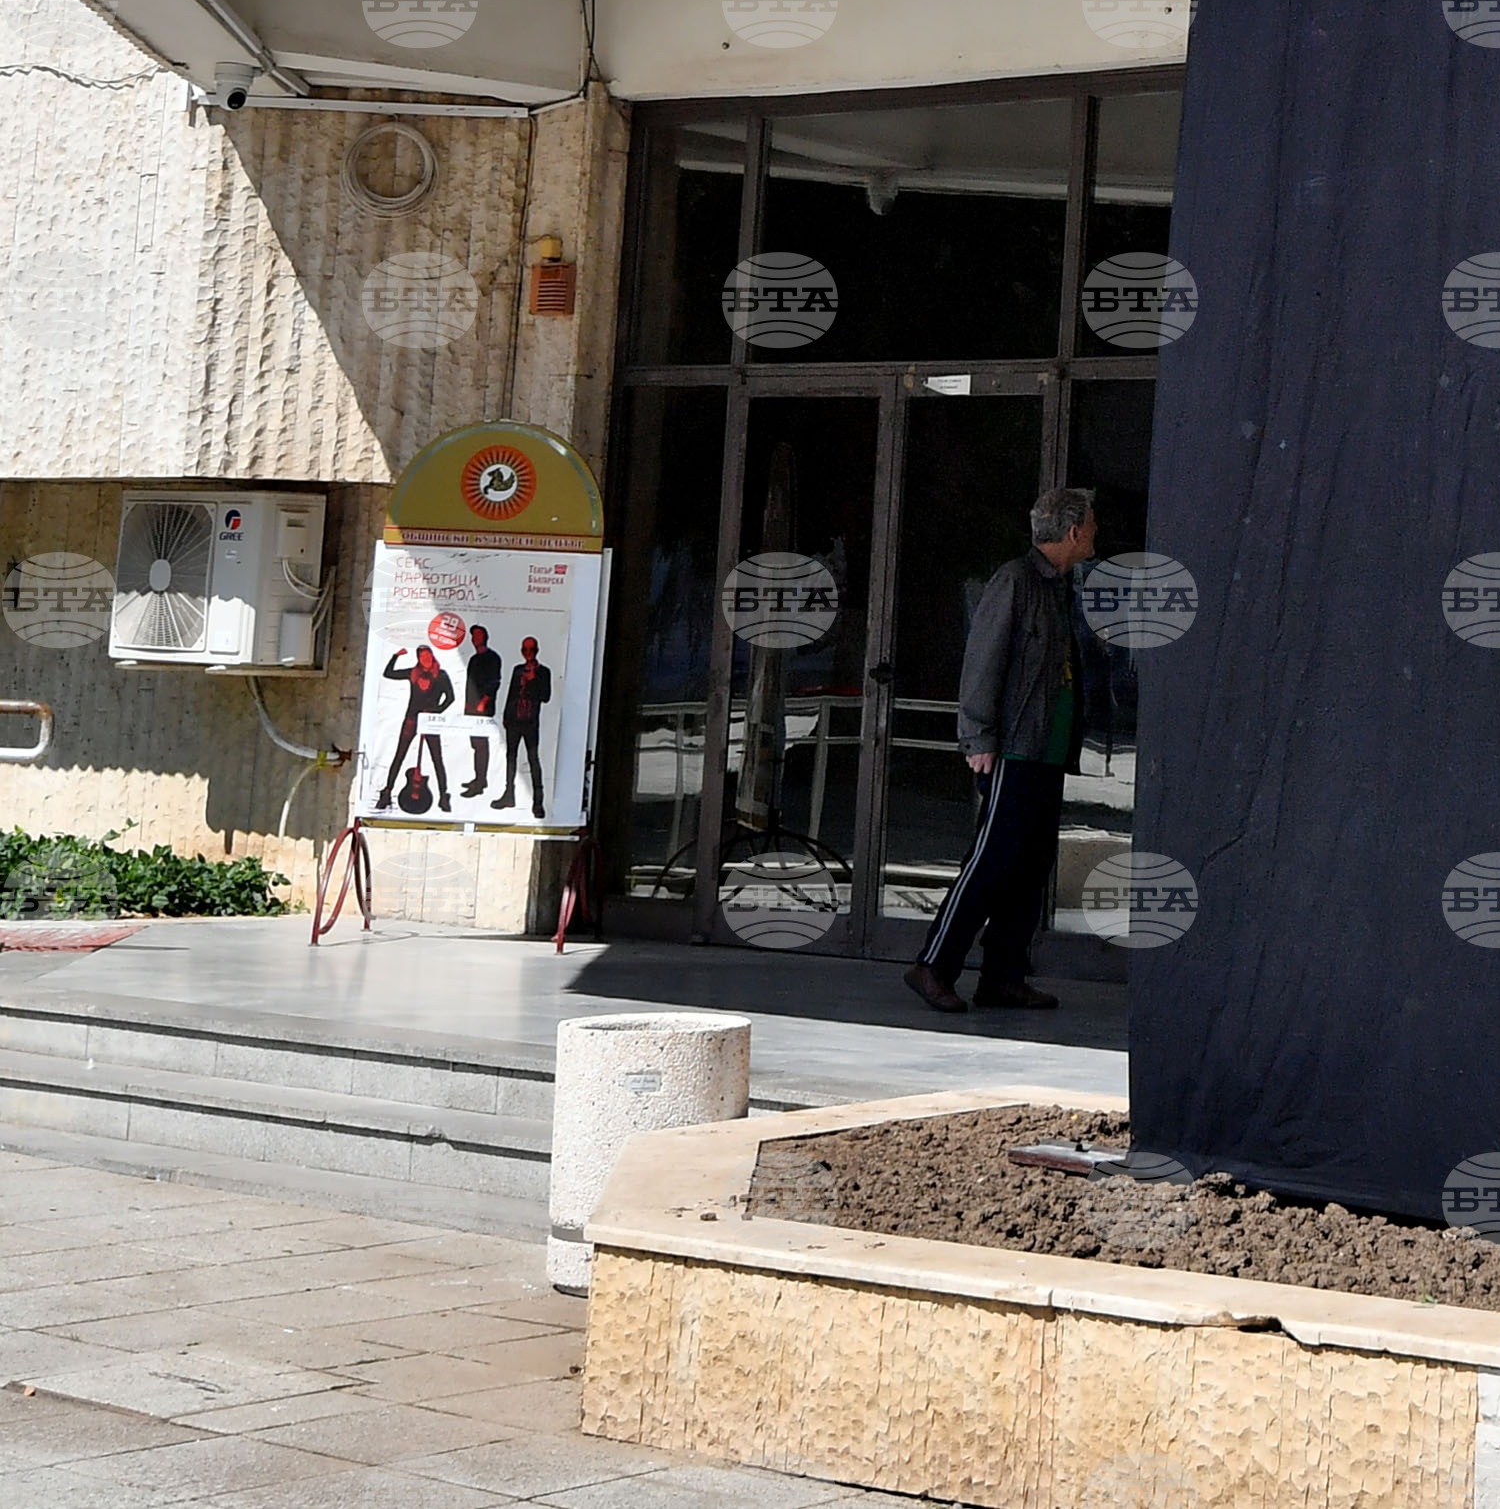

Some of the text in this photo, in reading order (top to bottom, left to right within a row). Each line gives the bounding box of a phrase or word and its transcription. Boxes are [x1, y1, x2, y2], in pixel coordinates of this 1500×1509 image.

[219, 532, 244, 541] GREE
[396, 557, 433, 571] СЕКС,
[395, 573, 481, 587] НАРКОТИЦИ,
[393, 587, 475, 601] РОКЕНДРОЛ
[440, 614, 459, 631] 29
